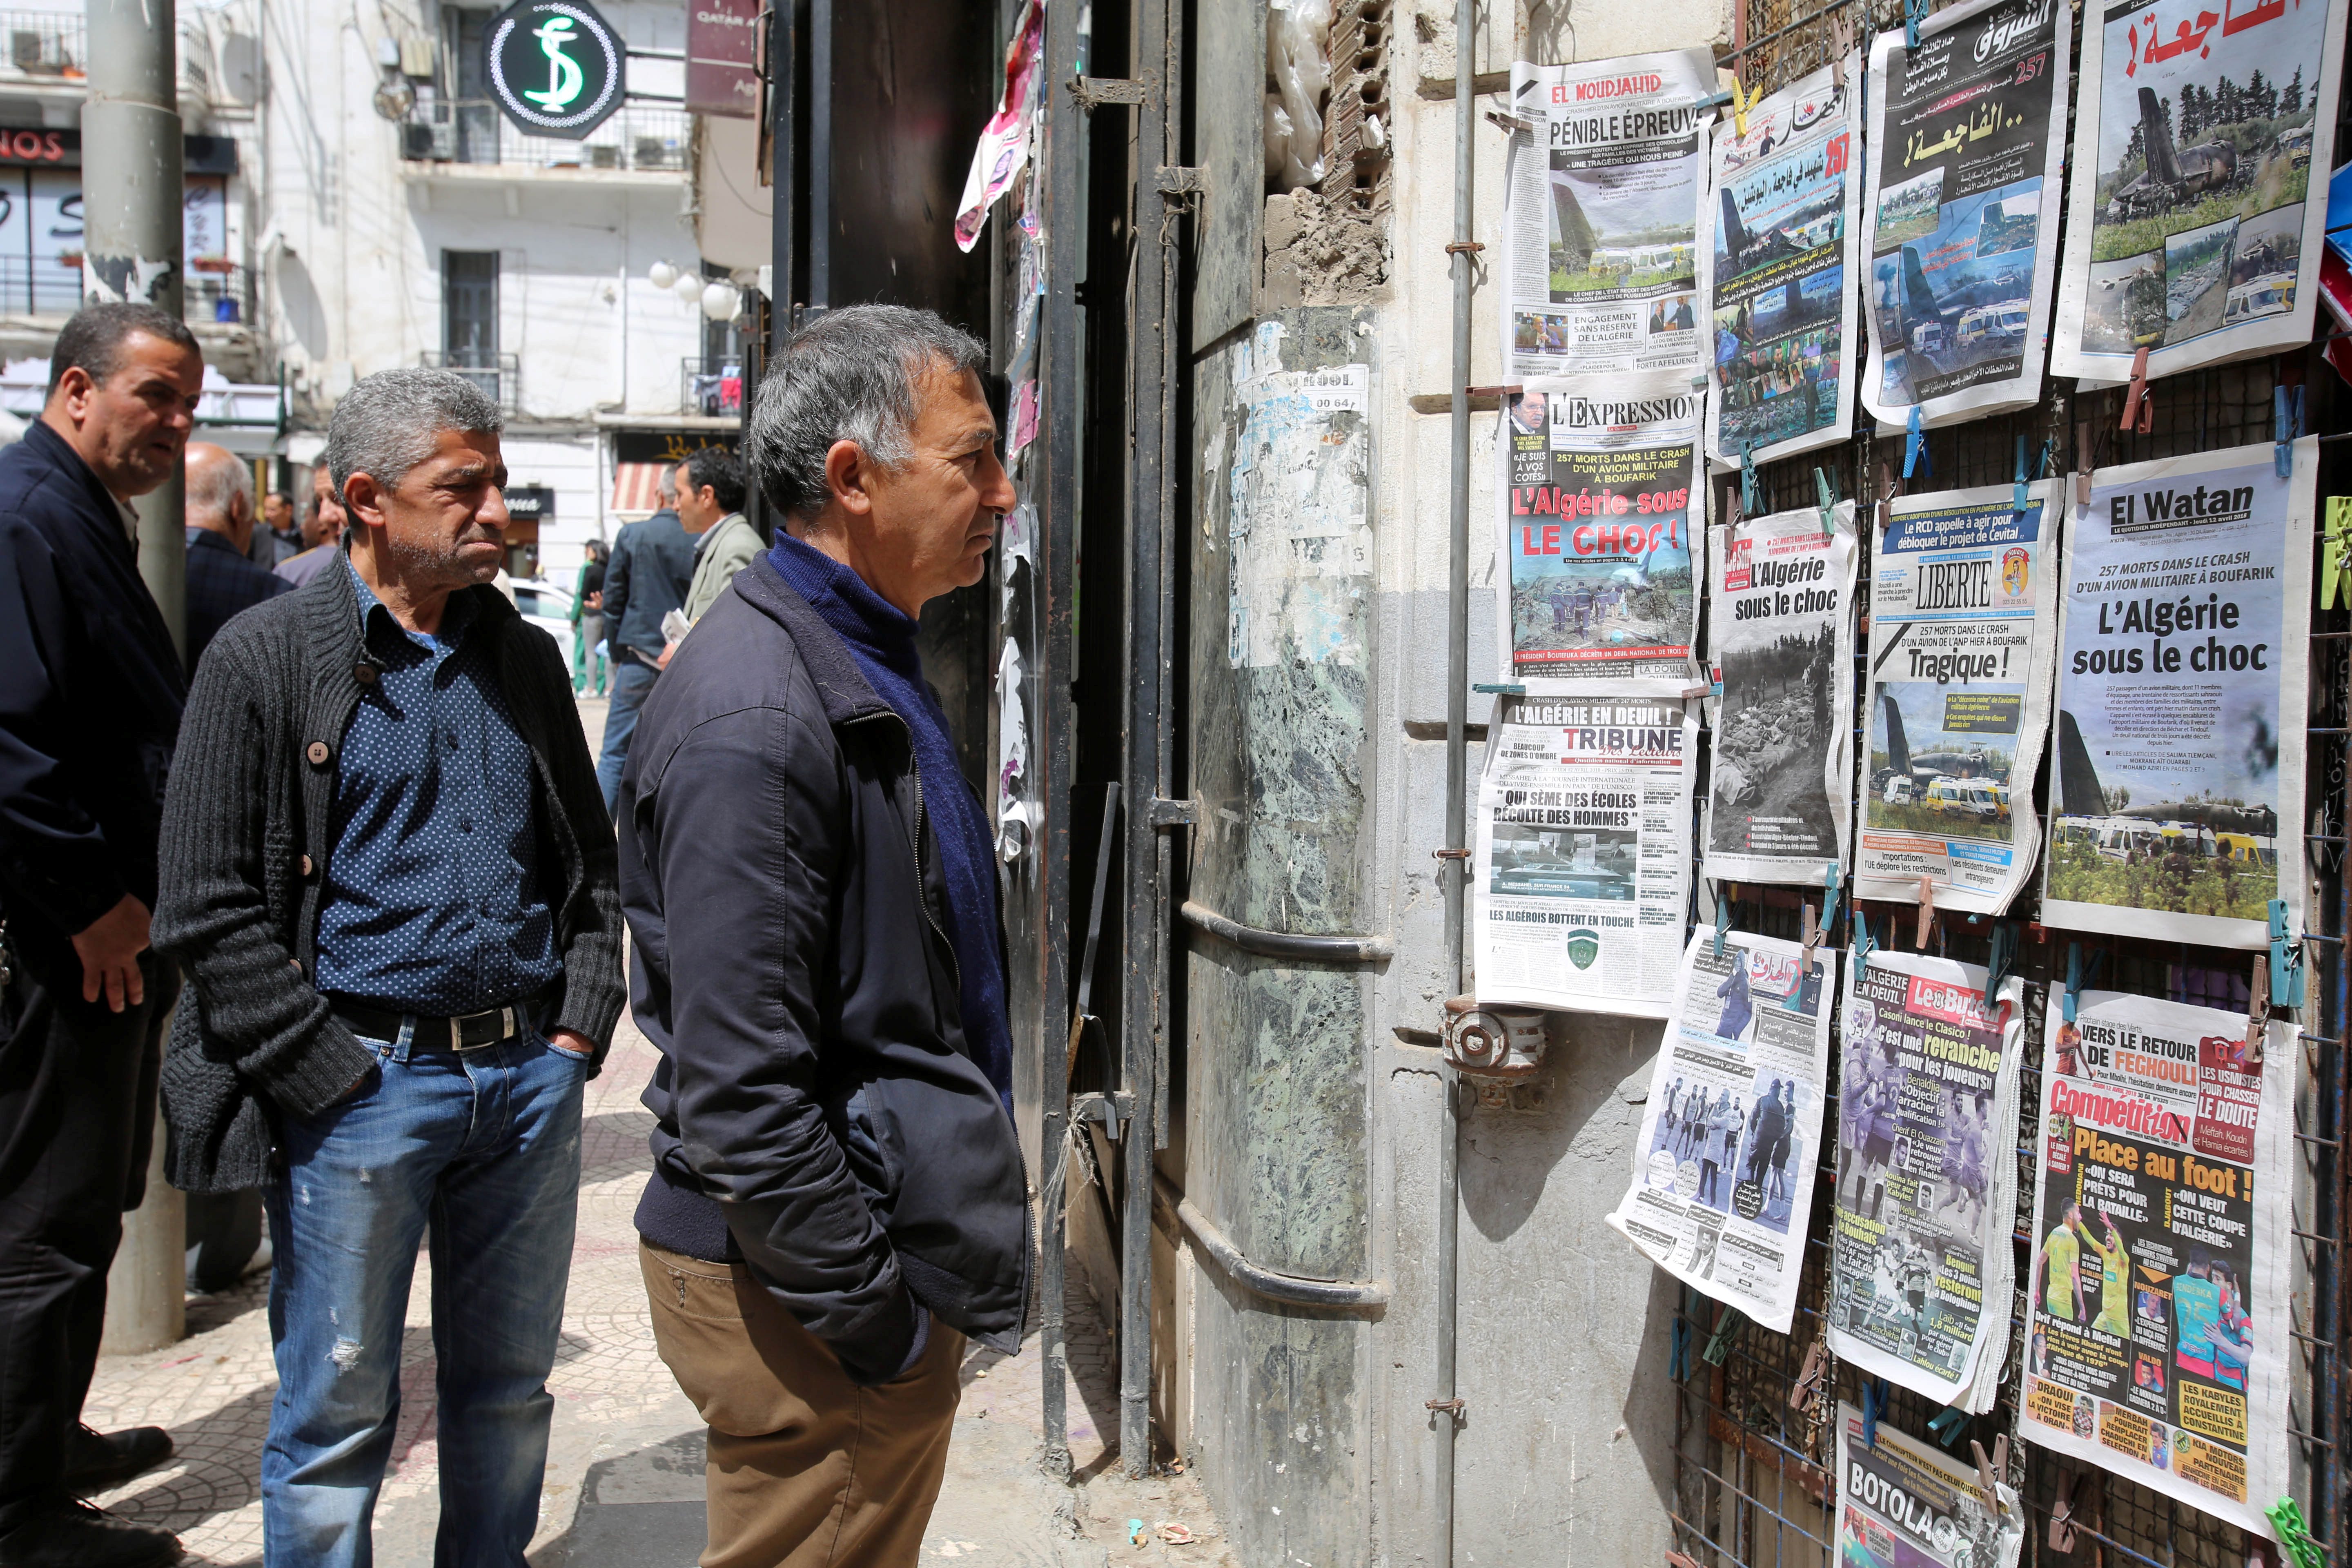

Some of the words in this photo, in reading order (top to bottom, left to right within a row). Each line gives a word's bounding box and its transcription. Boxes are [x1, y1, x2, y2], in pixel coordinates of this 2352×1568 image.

[2015, 52, 2046, 85] 257
[1552, 86, 1568, 104] EL
[1576, 74, 1662, 101] MOUDJAHID
[1550, 116, 1619, 145] PÉNIBLE
[1825, 132, 1850, 178] 257
[1574, 325, 1598, 333] SANS
[1600, 321, 1638, 331] RÉSERVE
[1575, 313, 1637, 324] ENGAGEMENT
[1578, 334, 1591, 342] DE
[1316, 399, 1330, 407] 00
[1334, 399, 1348, 407] 64
[1557, 454, 1572, 462] 257
[1575, 454, 1610, 463] MORTS
[1614, 453, 1641, 462] DANS
[1644, 452, 1656, 460] LE
[1658, 448, 1690, 459] CRASH
[1512, 487, 1628, 521] L'Algérie
[1637, 488, 1688, 516] sous
[2110, 494, 2135, 526] El
[2143, 485, 2254, 522] Watan
[1522, 525, 1561, 556] LE
[1572, 523, 1663, 555] CHOC
[1669, 519, 1678, 549] !
[1905, 522, 1913, 535] Le
[1915, 520, 1933, 534] RCD
[1934, 516, 1964, 532] appelle
[1966, 517, 1971, 529] à
[1973, 514, 1990, 530] agir
[1991, 514, 2013, 528] pour
[1898, 537, 1938, 552] débloquer
[1940, 536, 1948, 546] le
[1949, 532, 1974, 548] projet
[1976, 531, 1987, 543] de
[1989, 526, 2019, 541] Cevital
[2007, 548, 2025, 558] Nouara
[2099, 565, 2118, 577] 257
[2120, 560, 2159, 575] MORTS
[2161, 559, 2193, 572] DANS
[2195, 557, 2208, 569] LE
[2210, 551, 2251, 566] CRASH
[1735, 597, 1771, 620] sous
[1775, 592, 1790, 616] le
[1794, 588, 1838, 613] choc
[2098, 593, 2239, 637] L'Algérie
[1920, 626, 1933, 635] 257
[1934, 626, 1956, 635] MORTS
[1958, 626, 1976, 634] DANS
[1978, 625, 1985, 634] LE
[1987, 625, 2009, 634] CRASH
[1909, 647, 1996, 684] Tragique
[2001, 647, 2009, 678] !
[2071, 645, 2144, 675] sous
[2152, 638, 2181, 674] le
[2189, 635, 2268, 672] choc
[1515, 704, 1588, 725] L'ALGÉRIE
[1592, 706, 1612, 725] EN
[1615, 707, 1662, 725] DEUIL
[1666, 708, 1672, 725] !
[1563, 728, 1682, 751] TRIBUNE
[1599, 744, 1623, 756] Des
[1629, 745, 1682, 757] Lecteurs
[1506, 791, 1527, 806] QUI
[1530, 790, 1563, 806] SÈME
[1565, 793, 1588, 808] DES
[1592, 792, 1636, 808] ÉCOLES
[1493, 807, 1544, 823] RÉCOLTE
[1547, 810, 1570, 824] DES
[1573, 811, 1629, 826] HOMMES
[1489, 910, 1504, 921] LES
[1506, 911, 1547, 923] ALGÉROIS
[1548, 913, 1585, 925] BOTTENT
[1588, 916, 1599, 926] EN
[1601, 915, 1635, 928] TOUCHE
[1914, 980, 1932, 1008] Le
[1879, 1007, 1903, 1023] Casoni
[1904, 1014, 1925, 1029] lance
[1926, 1020, 1933, 1031] le
[1935, 1022, 1965, 1039] Clasico
[1967, 1029, 1971, 1040] !
[1903, 1035, 1922, 1053] une
[1922, 1034, 2001, 1074] revanche
[2082, 1024, 2116, 1046] VERS
[2120, 1031, 2136, 1050] LE
[2141, 1036, 2196, 1062] RETOUR
[1898, 1051, 1924, 1071] pour
[1925, 1056, 1941, 1078] les
[2088, 1045, 2109, 1067] DE
[2114, 1050, 2197, 1087] FEGHOULI
[2200, 1066, 2215, 1079] LES
[2217, 1069, 2262, 1090] USMISTES
[2200, 1084, 2222, 1097] POUR
[2223, 1088, 2260, 1105] CHASSER
[2050, 1079, 2191, 1144] Compétition
[2197, 1102, 2214, 1119] LE
[2215, 1104, 2258, 1129] DOUTE
[2073, 1127, 2138, 1174] Place
[2144, 1152, 2175, 1180] au
[2183, 1155, 2237, 1198] foot
[2243, 1170, 2253, 1203] !
[1945, 1253, 1976, 1275] Benguit
[1934, 1275, 1982, 1303] resteront
[2134, 1281, 2173, 1301] NOUZARET
[2183, 1383, 2199, 1396] LES
[2201, 1388, 2242, 1407] KABYLES
[2183, 1417, 2245, 1442] CONSTANTINE
[2192, 1439, 2208, 1451] KIA
[2212, 1446, 2244, 1466] MOTORS
[1850, 1462, 1934, 1542] BOTOLA
